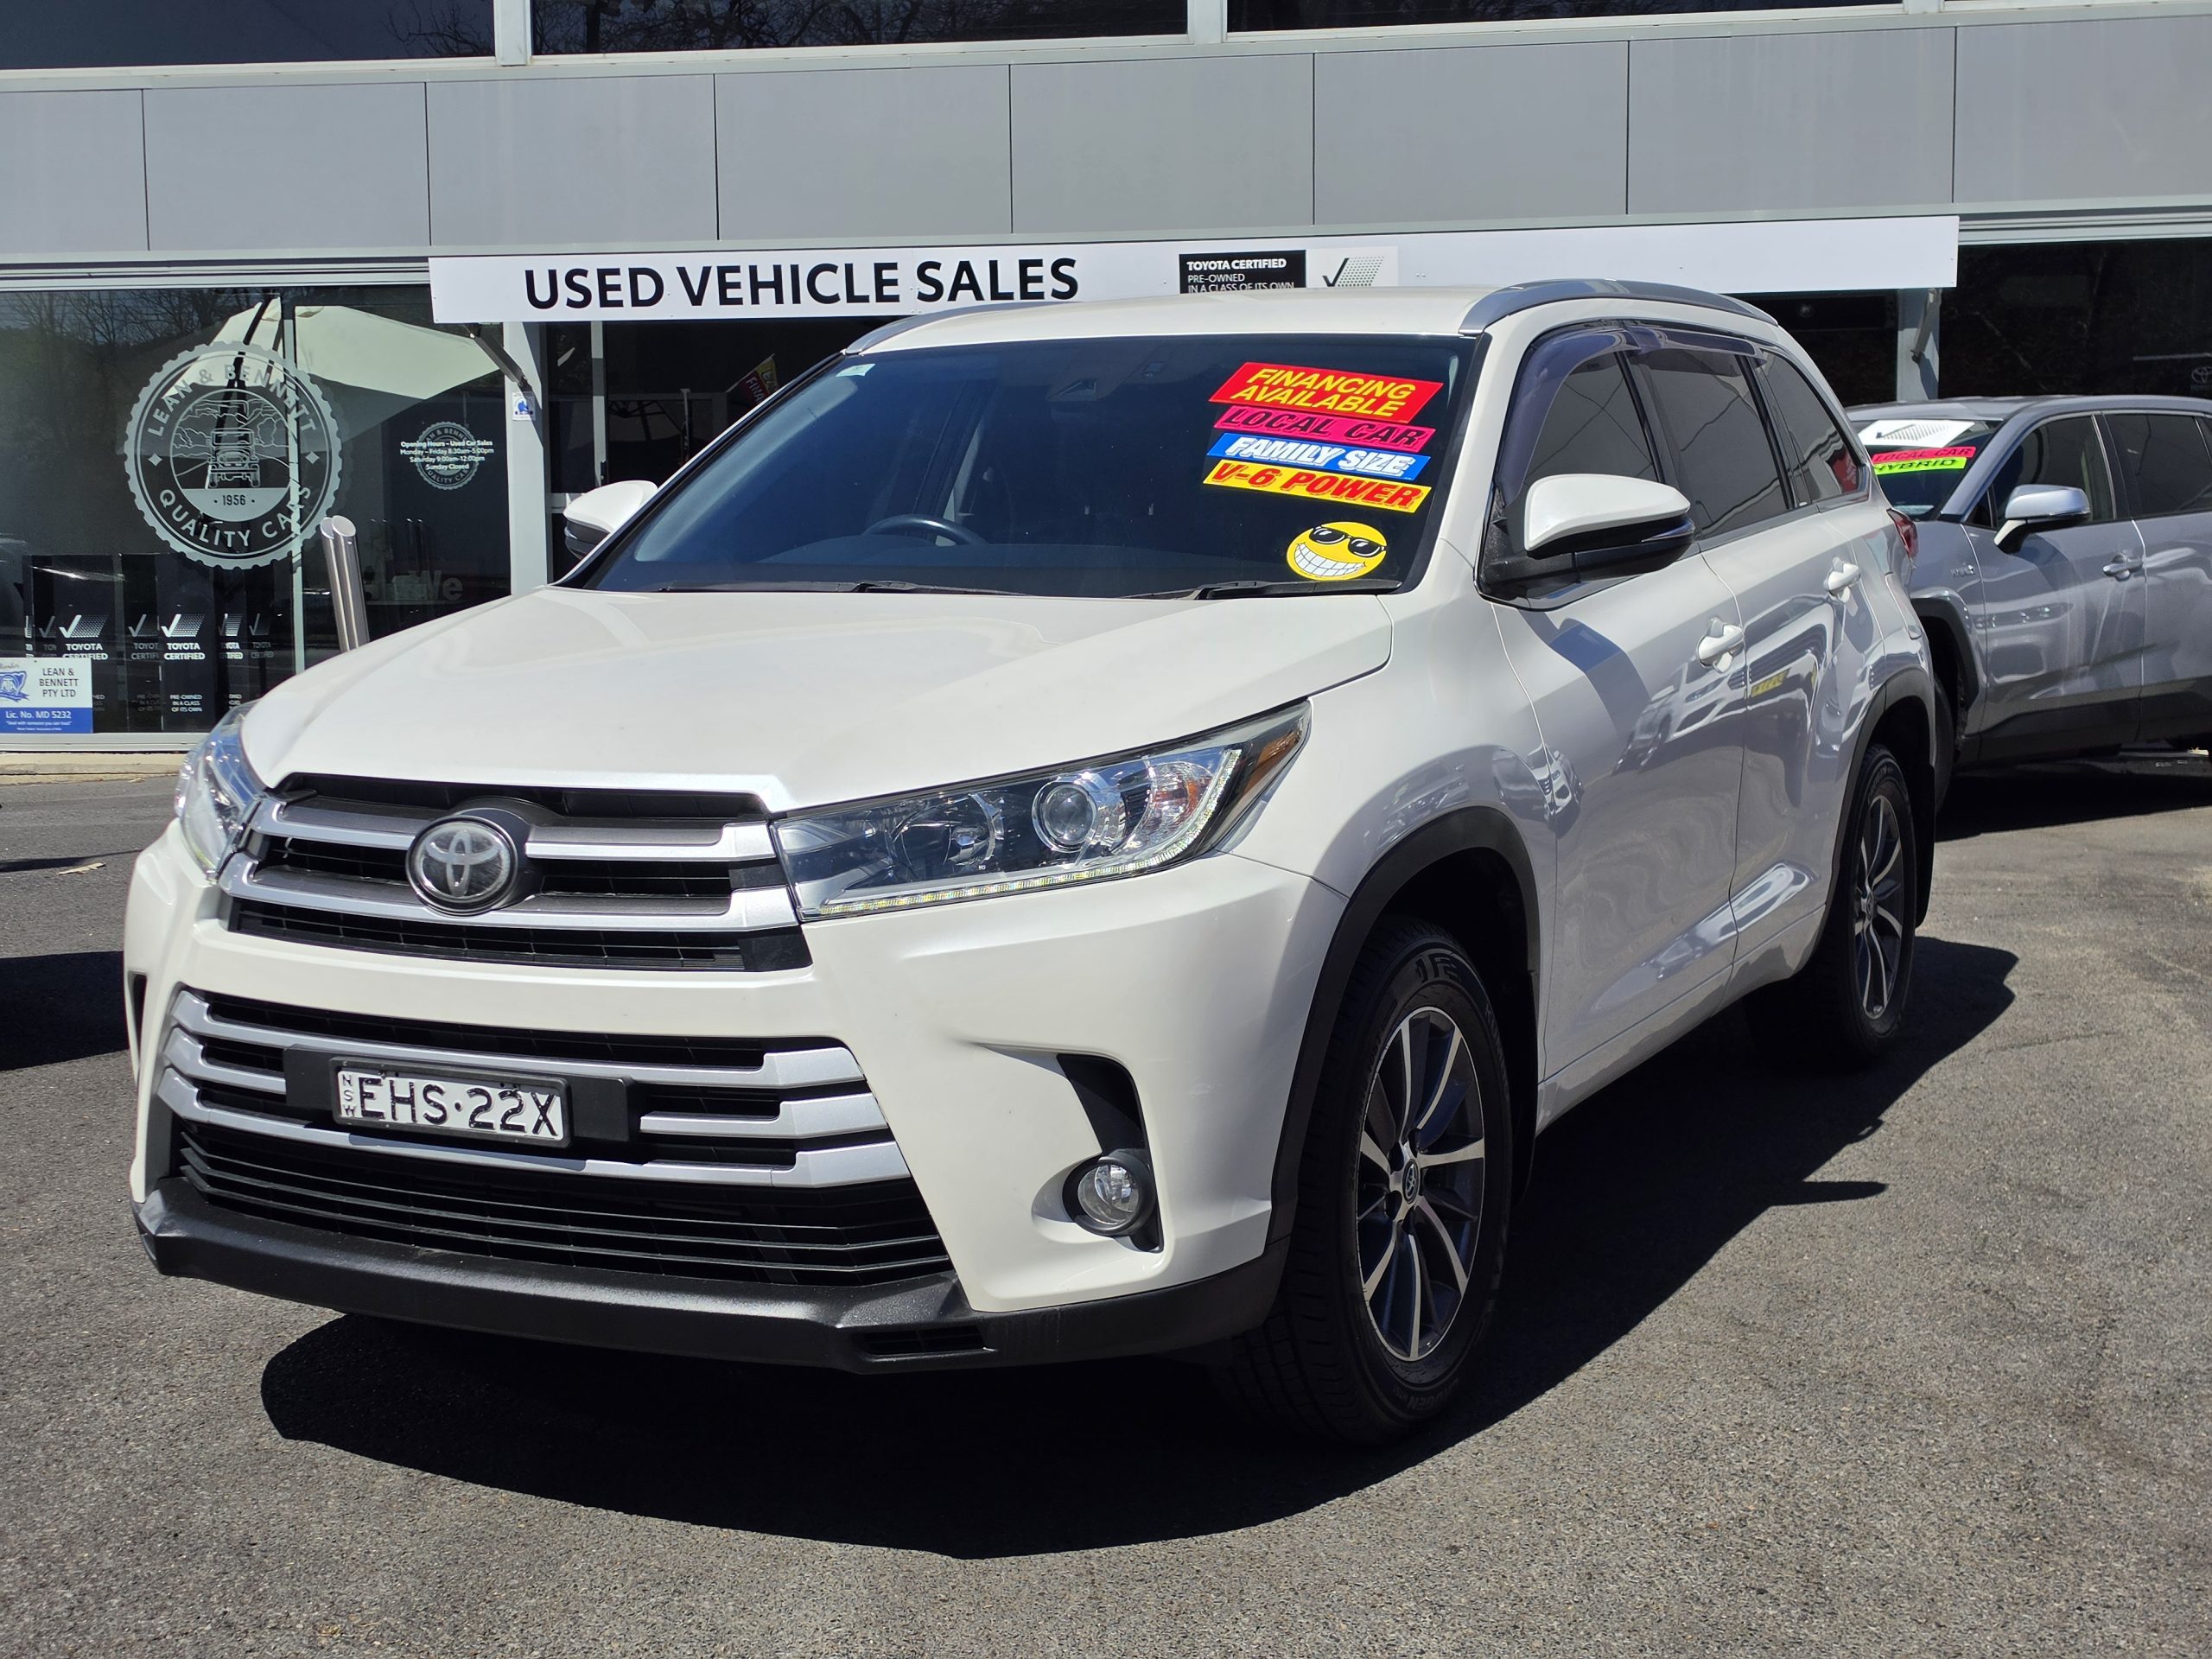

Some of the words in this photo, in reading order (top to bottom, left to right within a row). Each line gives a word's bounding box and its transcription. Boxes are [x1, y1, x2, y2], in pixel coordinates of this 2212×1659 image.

[1186, 260, 1230, 271] TOYOTA
[1231, 258, 1287, 270] CERTIFIED
[524, 266, 665, 309] USED
[677, 261, 899, 307] VEHICLE
[916, 257, 1080, 302] SALES
[1188, 273, 1245, 283] PRE-OWNED
[1188, 285, 1198, 294] IN
[1199, 284, 1207, 294] A
[1246, 367, 1416, 400] FINANCING
[148, 378, 194, 437] LEAN
[200, 369, 215, 385] &
[224, 363, 317, 433] BENNETT
[1230, 385, 1407, 417] AVAILABLE
[1222, 408, 1330, 437] LOCAL
[1346, 423, 1426, 448] CAR
[1225, 437, 1345, 467] FAMILY
[1338, 447, 1417, 476] SIZE
[1874, 450, 1927, 463] LOCAL
[1935, 448, 1973, 457] CAR
[1211, 461, 1283, 486] V-6
[1281, 471, 1425, 511] POWER
[221, 494, 246, 506] 1956
[159, 488, 251, 548] QUALITY
[262, 486, 312, 539] CARS
[166, 642, 200, 651] TOYOTA
[42, 667, 66, 677] LEAN
[67, 667, 75, 677] &
[39, 678, 79, 687] BENNETT
[42, 689, 59, 698] PTY
[60, 689, 77, 698] LTD
[5, 710, 19, 719] Lic.
[20, 710, 35, 719] No.
[35, 710, 50, 719] MD
[52, 710, 72, 719] 5232
[342, 1073, 357, 1118] NSW
